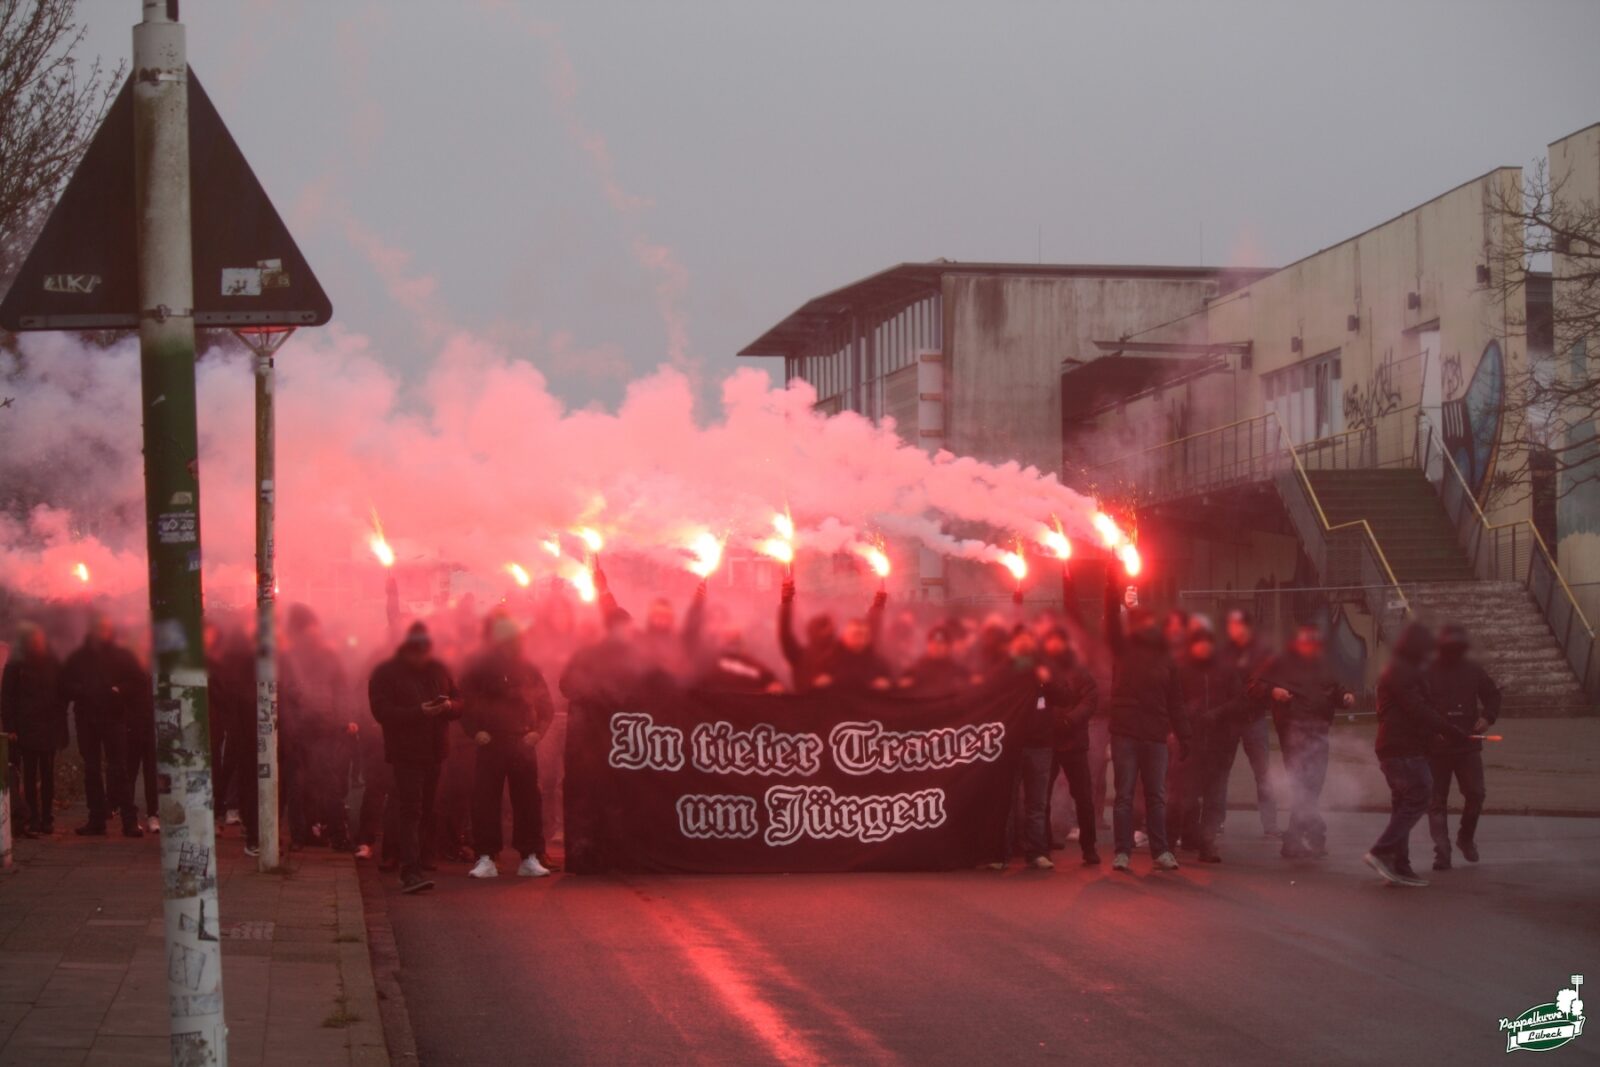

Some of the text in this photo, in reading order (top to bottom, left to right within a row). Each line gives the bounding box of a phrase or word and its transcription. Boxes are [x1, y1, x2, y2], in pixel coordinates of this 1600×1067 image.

[609, 712, 1006, 776] In tiefer Trauer
[675, 785, 947, 847] um Jürgen
